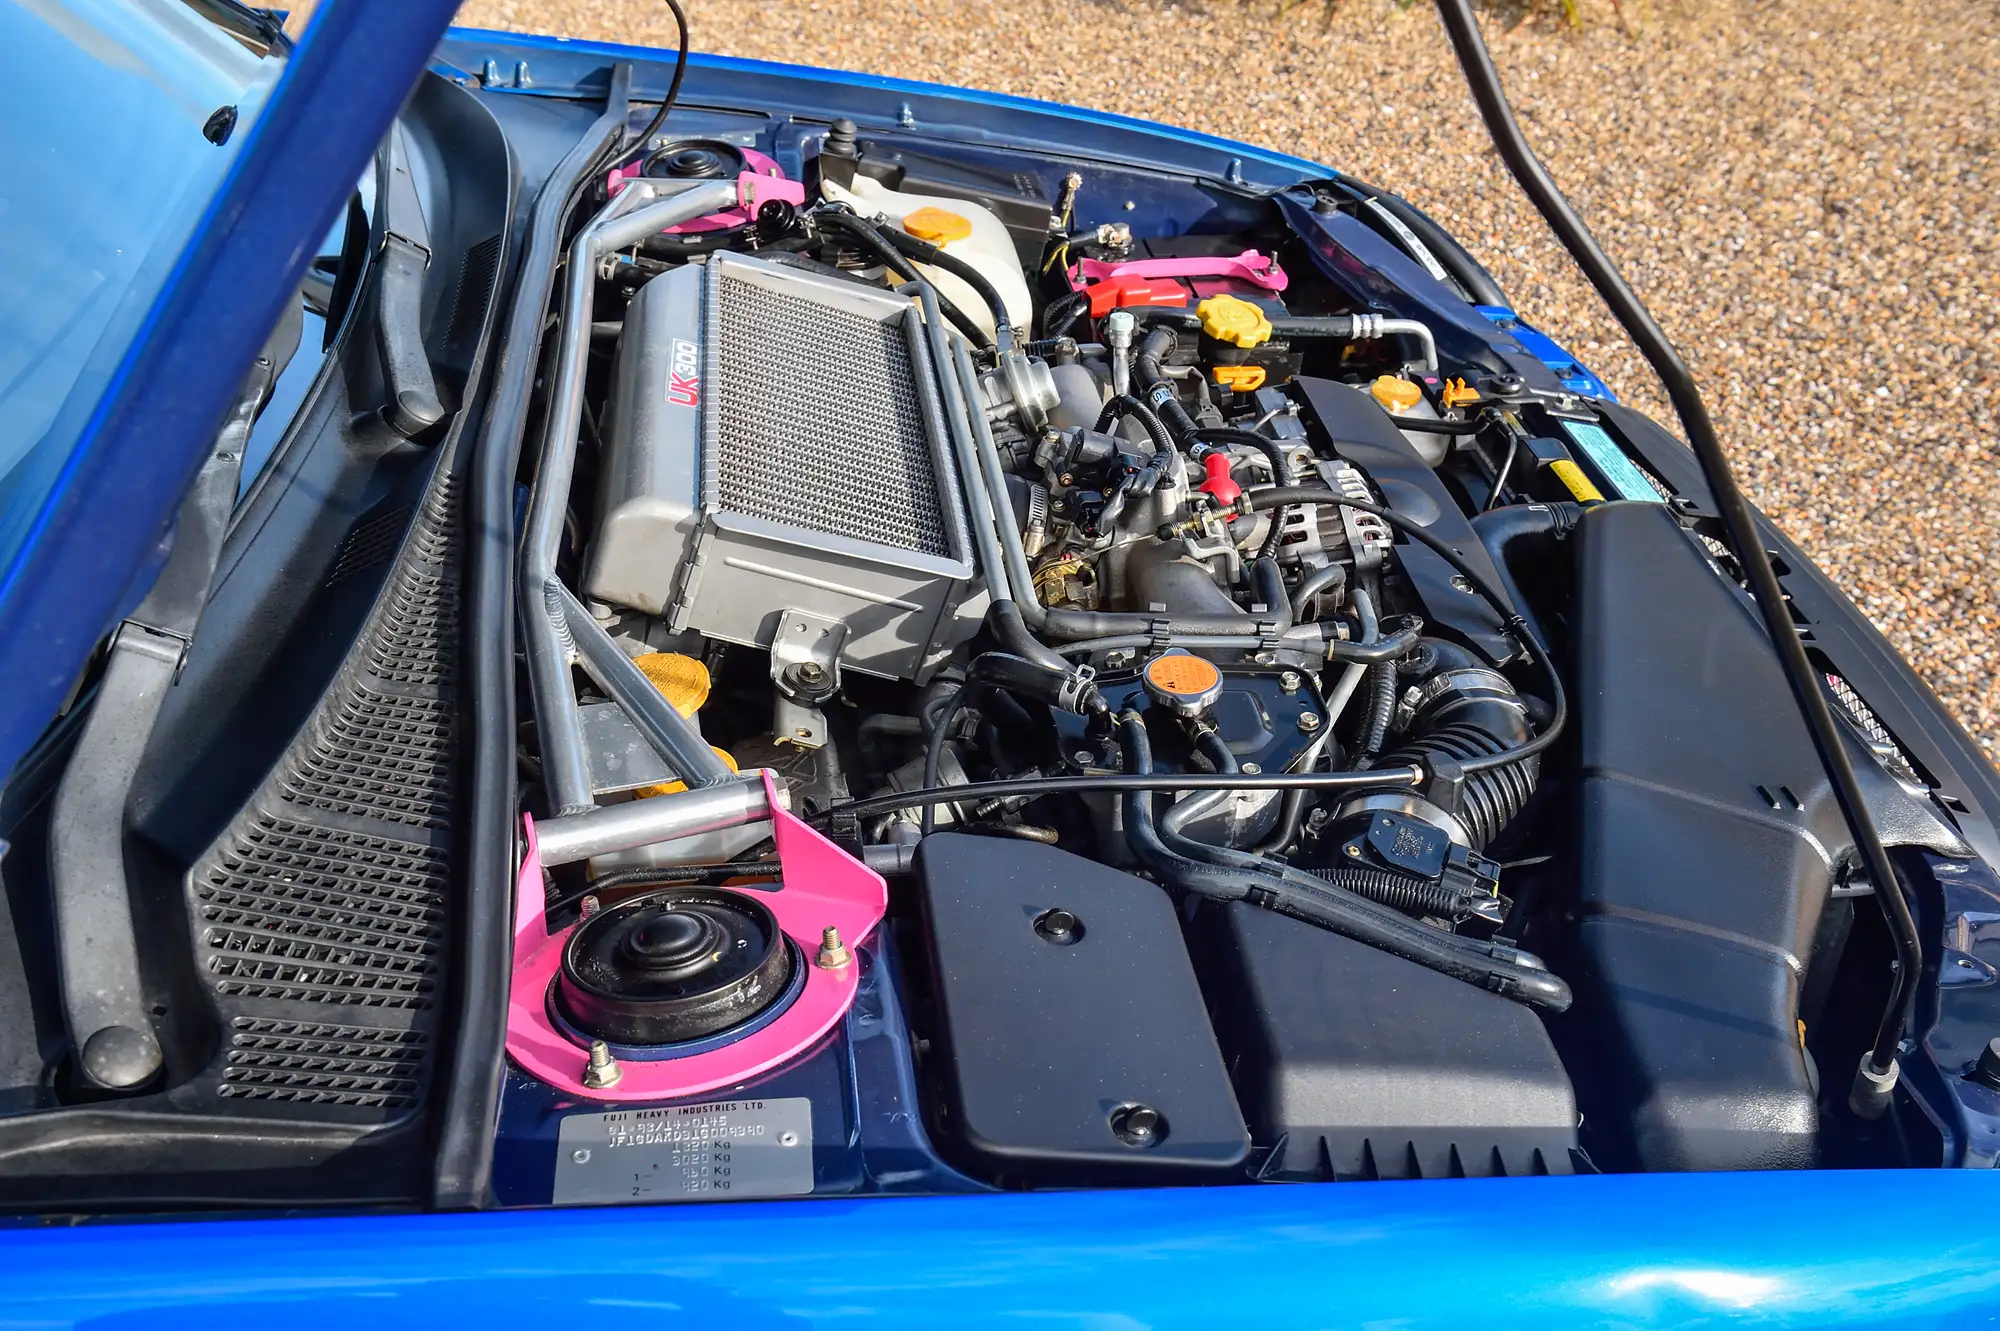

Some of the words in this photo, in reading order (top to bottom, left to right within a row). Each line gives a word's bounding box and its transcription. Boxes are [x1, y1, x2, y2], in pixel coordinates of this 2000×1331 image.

[668, 342, 699, 407] UK300
[603, 1114, 627, 1122] FUJI
[636, 1110, 670, 1119] HEAVY
[678, 1102, 737, 1115] INDUSTRIES
[714, 1140, 731, 1150] Kg
[714, 1153, 731, 1163] Kg
[714, 1166, 731, 1176] Kg
[713, 1180, 731, 1190] Kg
